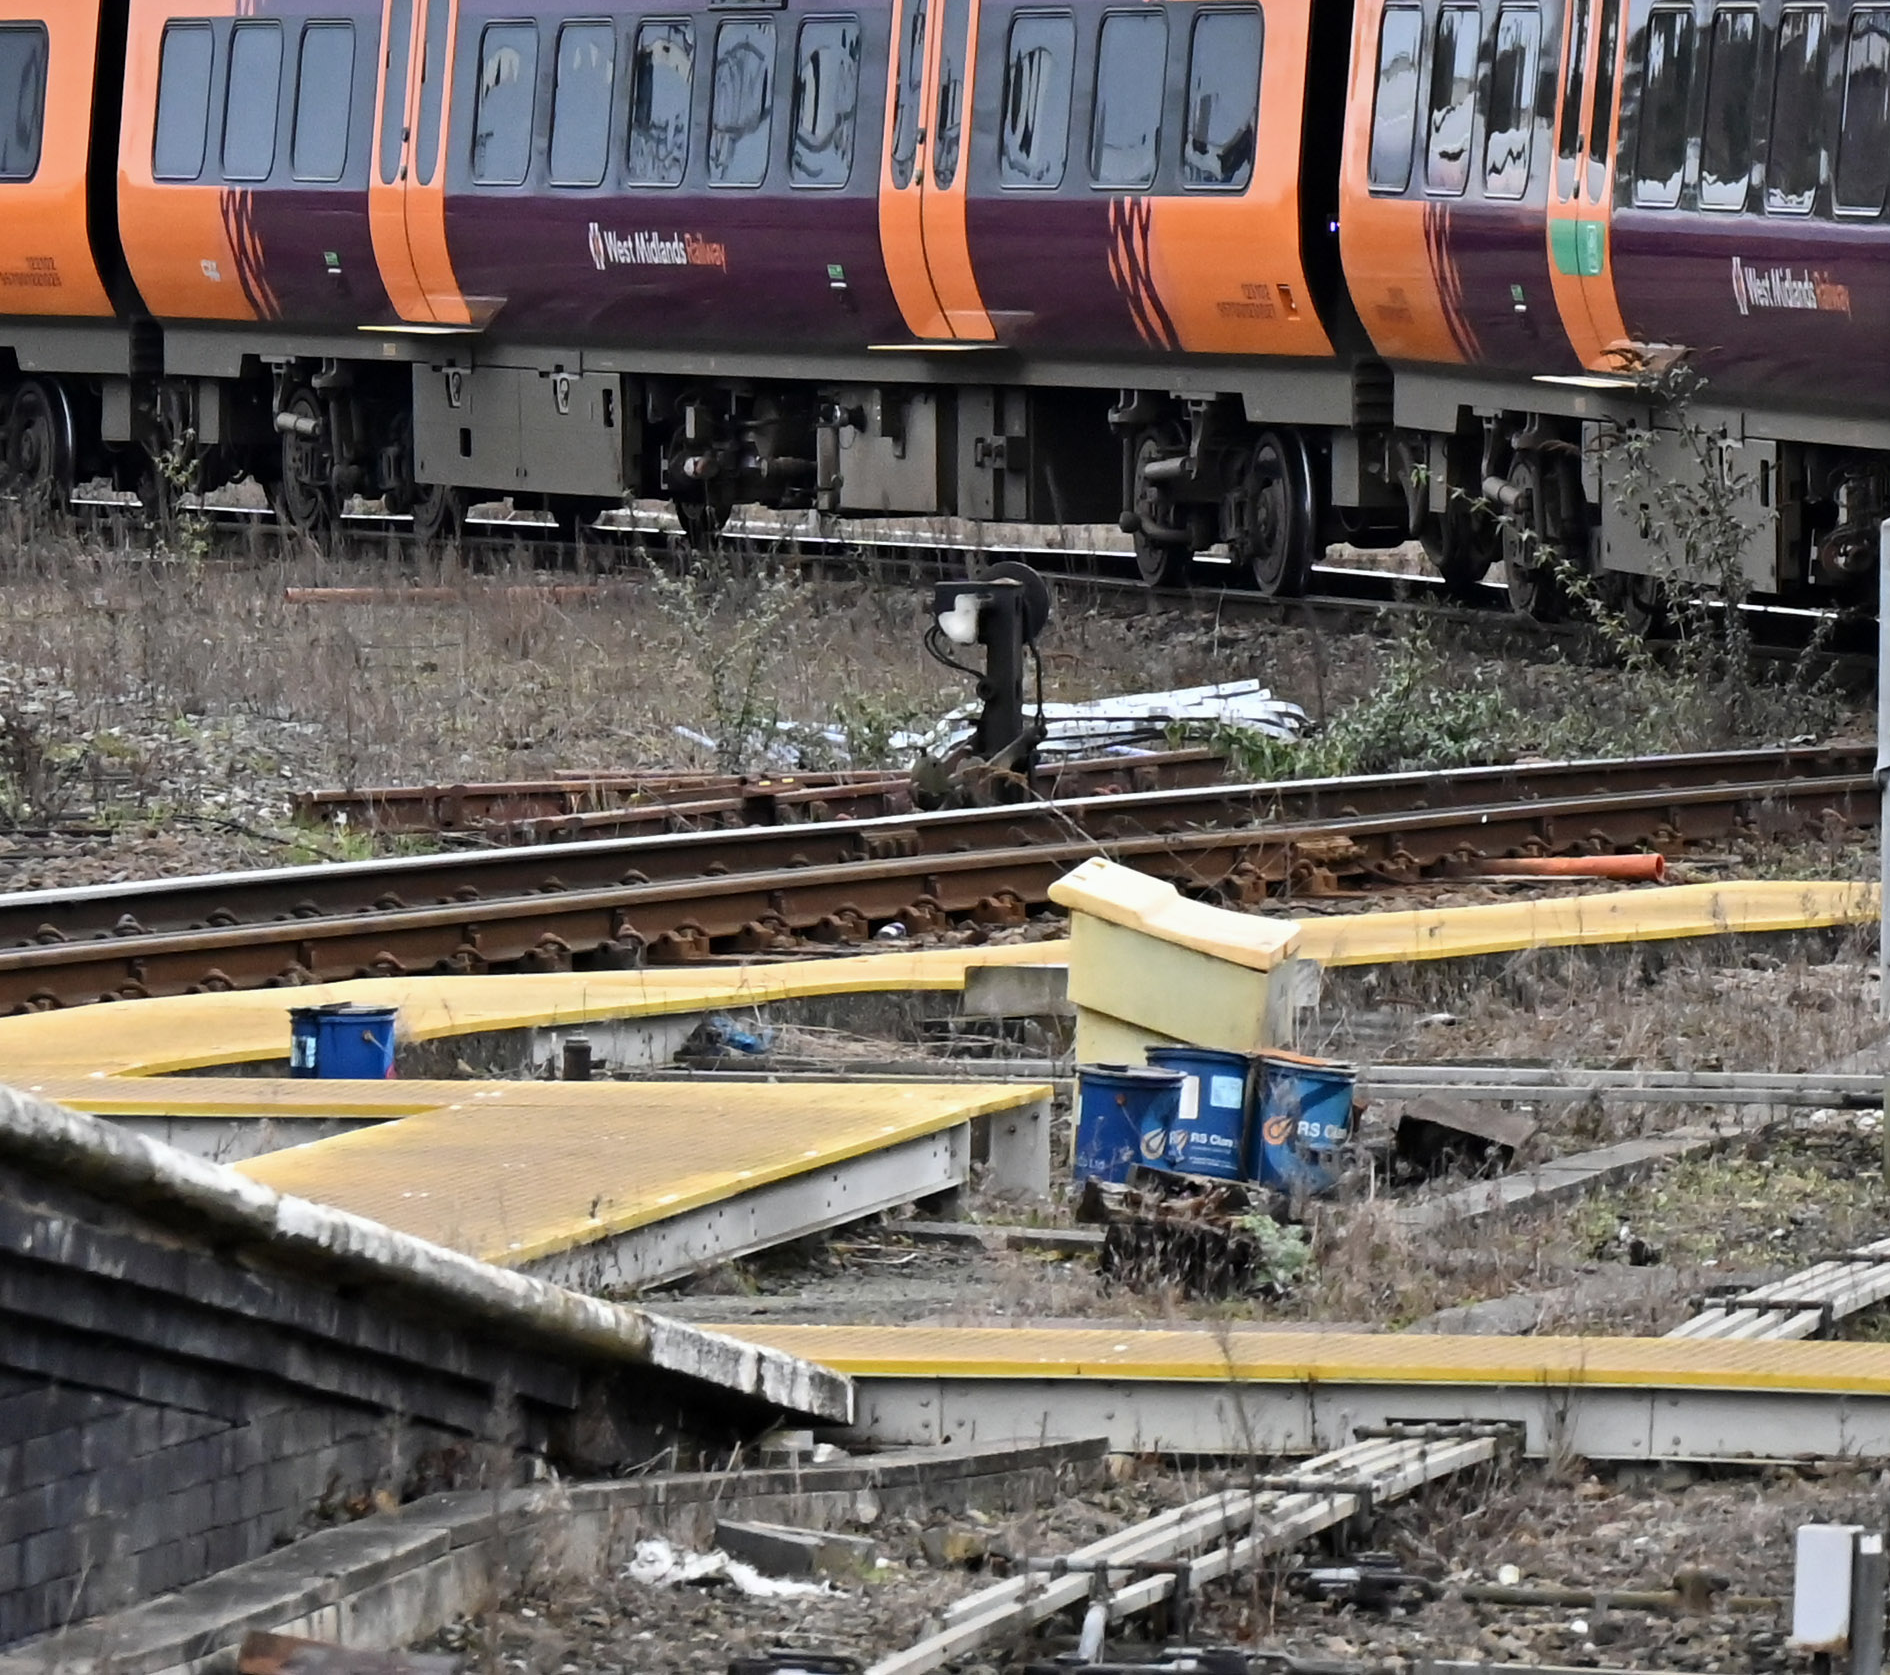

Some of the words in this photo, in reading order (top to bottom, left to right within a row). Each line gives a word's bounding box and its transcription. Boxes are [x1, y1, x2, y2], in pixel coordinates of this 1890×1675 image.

[603, 230, 636, 264] West
[635, 230, 687, 265] Midlands
[684, 232, 728, 274] Railway
[1744, 267, 1774, 307] West
[1770, 267, 1818, 309] Midlands
[1190, 1131, 1208, 1144] RS
[1296, 1120, 1321, 1138] RS
